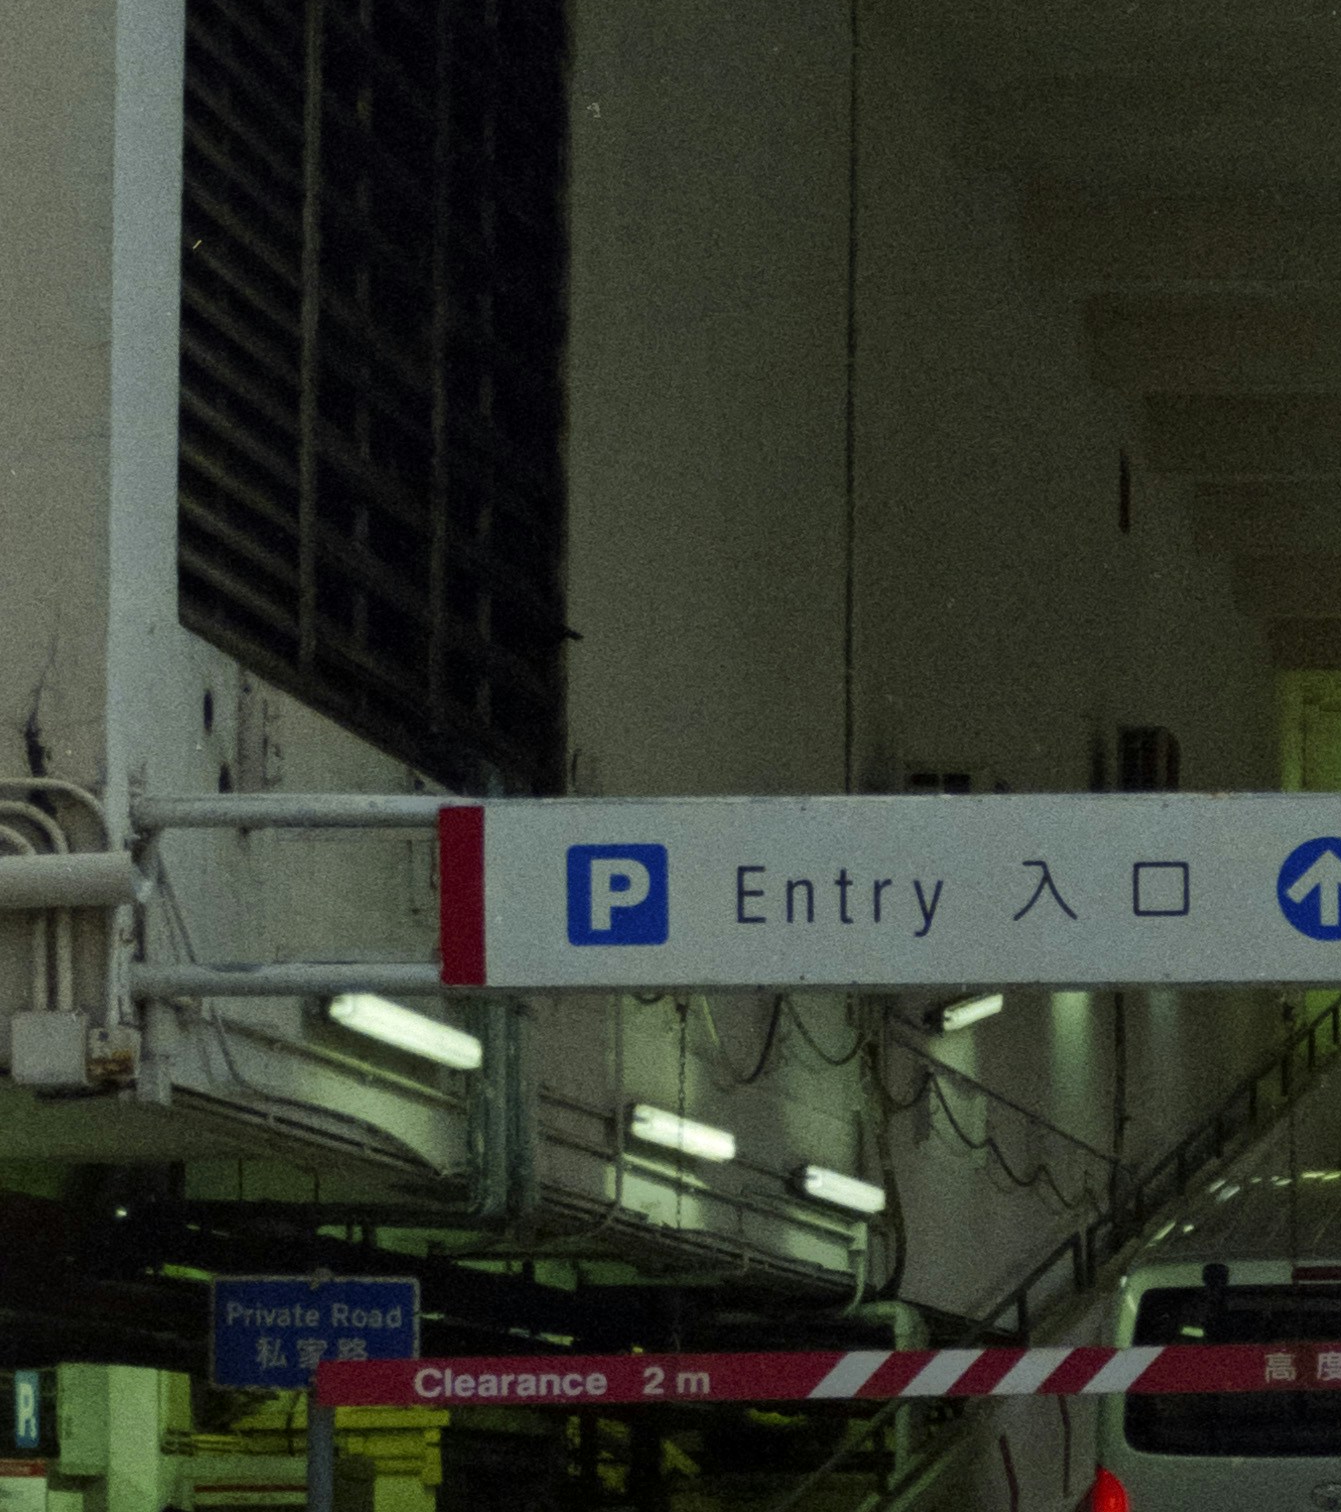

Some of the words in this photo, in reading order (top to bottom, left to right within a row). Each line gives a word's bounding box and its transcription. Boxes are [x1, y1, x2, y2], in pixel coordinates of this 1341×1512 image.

[590, 859, 651, 931] P
[736, 865, 944, 938] Entry
[1013, 860, 1190, 921] 入口
[226, 1301, 320, 1328] Private
[331, 1302, 403, 1329] Road
[255, 1335, 369, 1369] 私家路
[413, 1367, 608, 1399] Clearance
[642, 1366, 666, 1396] 2
[675, 1371, 712, 1396] m
